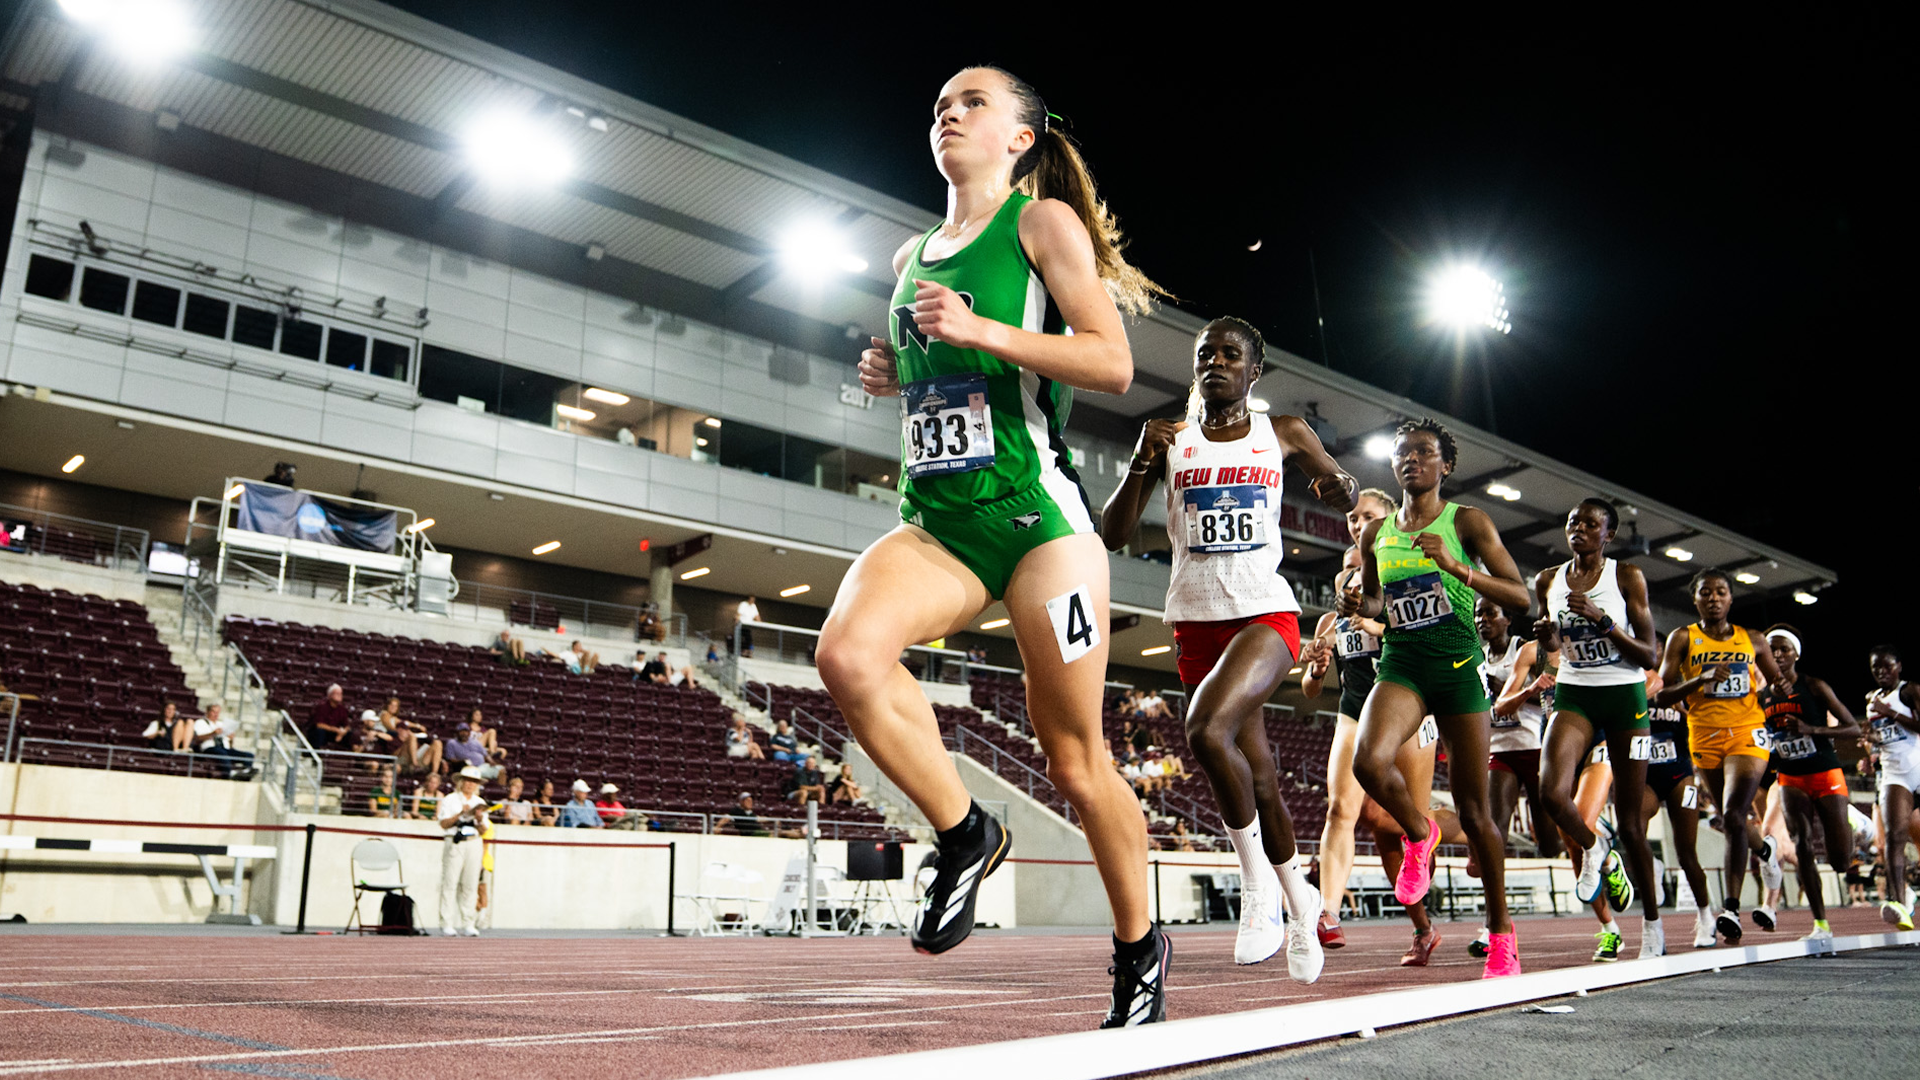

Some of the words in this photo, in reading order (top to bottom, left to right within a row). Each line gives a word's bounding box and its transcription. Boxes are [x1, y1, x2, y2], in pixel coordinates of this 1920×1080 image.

[840, 383, 875, 410] 2017
[911, 413, 969, 461] 933
[949, 459, 967, 469] TEXAS
[1174, 467, 1212, 490] NEW
[1216, 466, 1281, 489] MEXICO
[1201, 512, 1253, 544] 836
[1067, 592, 1093, 648] 4
[1393, 594, 1440, 625] 1027
[1346, 632, 1364, 653] 88
[1574, 640, 1609, 662] 150
[1691, 651, 1754, 667] MIZZOU
[1648, 706, 1681, 723] ZAGA
[1422, 720, 1436, 744] 10
[1756, 729, 1766, 747] 5
[1650, 744, 1668, 760] 03
[1781, 740, 1807, 758] 944
[1687, 787, 1696, 807] 7
